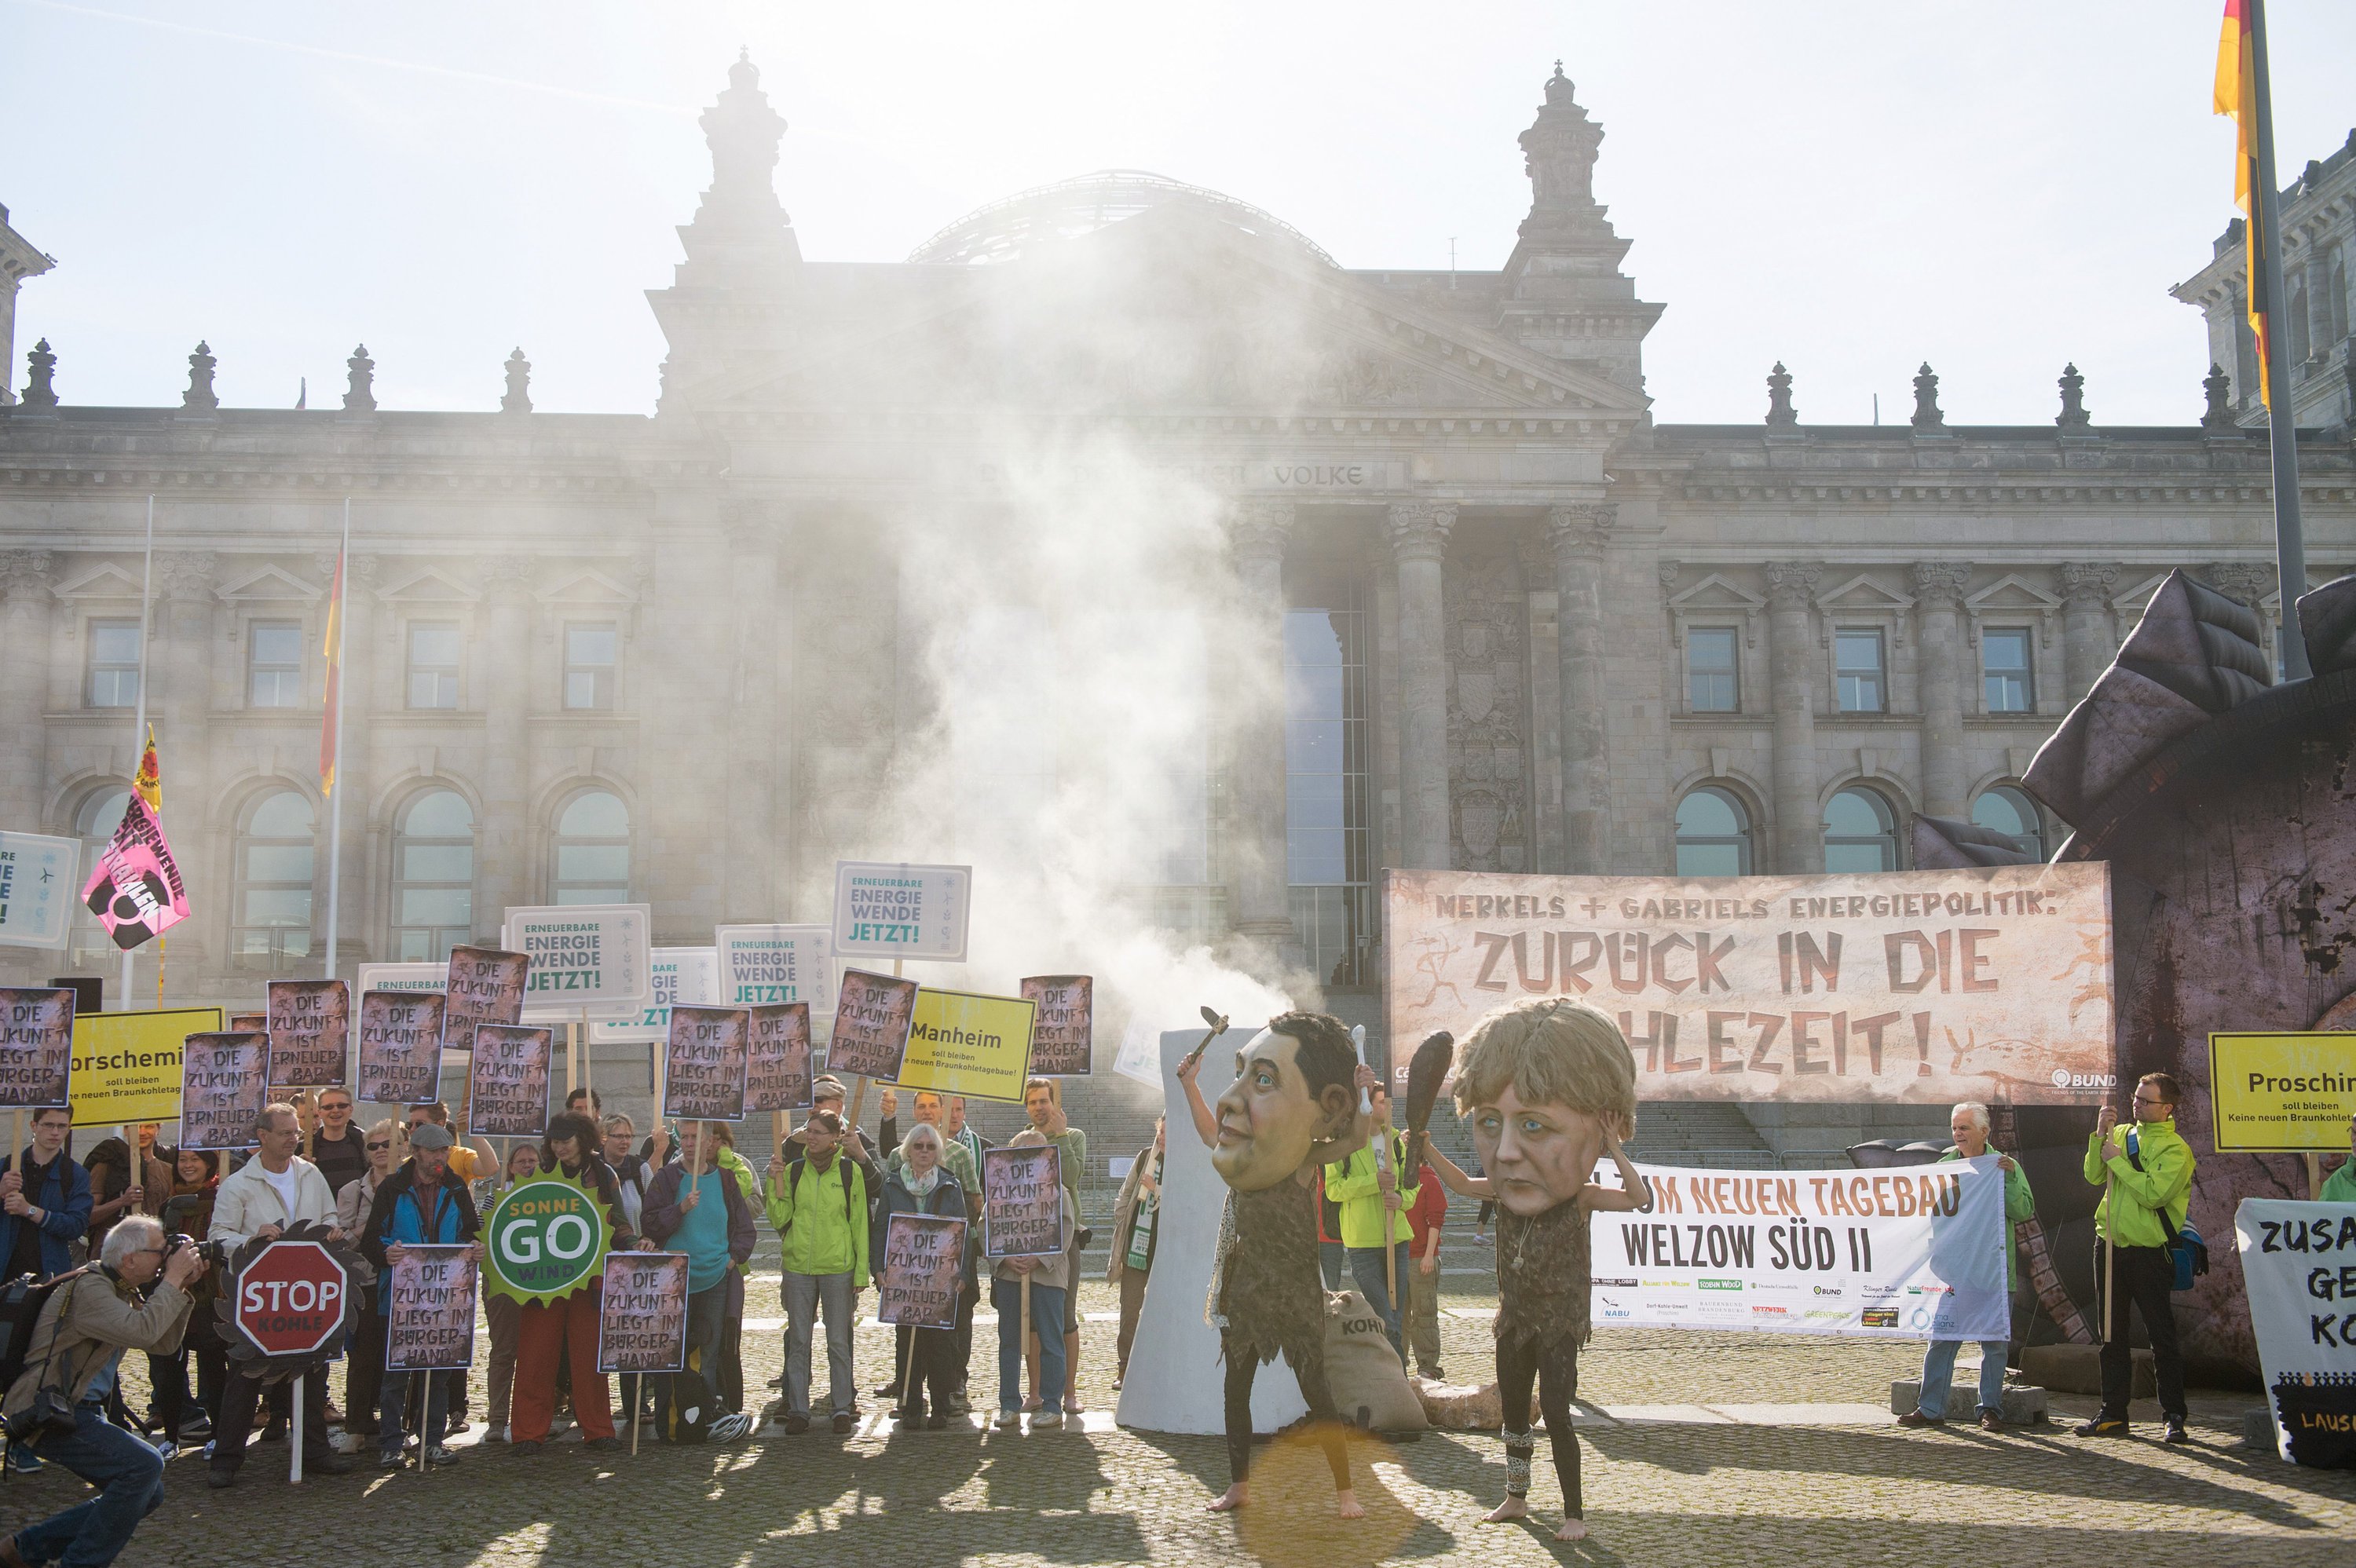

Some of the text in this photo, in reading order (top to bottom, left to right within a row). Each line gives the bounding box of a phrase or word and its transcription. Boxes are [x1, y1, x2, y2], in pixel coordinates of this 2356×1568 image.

[1274, 466, 1363, 485] VOLKE
[852, 877, 923, 888] ERNEUERBARE
[851, 889, 922, 905] ENERGIE
[1436, 894, 1565, 919] MERKELS
[1619, 897, 1768, 919] GABRIELS
[1790, 890, 2057, 919] ENERGIEPOLITIK:
[851, 905, 920, 921] WENDE
[525, 923, 600, 933] ERNEUERBARE
[848, 923, 920, 943] JETZT!
[525, 935, 600, 951] ENERGIE
[731, 941, 795, 949] ERNEUERBARE
[529, 951, 600, 968] WENDE
[732, 952, 796, 965] ENERGIE
[1473, 928, 1999, 996] ZURÜCK IN DIE
[475, 962, 501, 978] DIE
[734, 967, 796, 981] WENDE
[377, 981, 446, 990] ERNEUERBAR
[450, 979, 521, 999] ZUKUNFT
[526, 970, 601, 992] JETZT!
[734, 985, 796, 1003] JETZT!
[865, 989, 889, 1005] DIE
[1044, 990, 1067, 1004] DIE
[296, 995, 322, 1011] DIE
[471, 1000, 496, 1014] IST
[13, 1006, 42, 1022] DIE
[390, 1007, 416, 1024] DIE
[840, 1003, 906, 1028] ZUKUNFT
[1035, 1008, 1087, 1022] UKUNFT
[272, 1014, 342, 1031] ZUKUNFT
[759, 1020, 783, 1035] DIE
[0, 1028, 64, 1044] UKUNFT
[296, 1034, 320, 1047] IST
[364, 1028, 436, 1044] ZUKUNFT
[696, 1025, 722, 1040] DIE
[859, 1027, 881, 1039] IST
[910, 1022, 1002, 1049] Manheim
[1033, 1026, 1085, 1040] IEGT IN
[500, 1043, 525, 1058] DIE
[748, 1040, 805, 1055] UKUNFT
[1616, 1010, 1931, 1076] HLEZEIT!
[0, 1049, 63, 1065] EGT IN
[71, 1047, 182, 1072] orschemi
[214, 1051, 240, 1066] DIE
[272, 1050, 342, 1065] ERNEUER-
[386, 1048, 412, 1062] IST
[671, 1044, 742, 1061] ZUKUNFT
[931, 1050, 975, 1062] soll bleiben
[762, 1059, 782, 1073] IST
[850, 1054, 878, 1070] BAR
[911, 1058, 934, 1067] neuen
[936, 1060, 1017, 1077] Braunkohletagebaue!
[1037, 1058, 1074, 1071] HAND
[292, 1067, 324, 1081] BAR
[362, 1064, 432, 1080] ERNEUER-
[477, 1062, 545, 1079] ZUKUNFT
[671, 1065, 738, 1080] LIEGT IN
[106, 1076, 159, 1087] soll bleiben
[188, 1071, 263, 1087] ZUKUNFT
[747, 1074, 806, 1090] RNEUER-
[2072, 1074, 2116, 1087] BUND
[113, 1086, 181, 1097] Braunkohletag
[380, 1082, 412, 1097] BAR
[477, 1082, 541, 1098] LIEGT IN
[213, 1092, 238, 1106] IST
[759, 1092, 790, 1106] BAR
[682, 1100, 723, 1115] HAND
[488, 1117, 528, 1132] HAND
[207, 1127, 241, 1142] BAR
[1010, 1163, 1033, 1179] DIE
[990, 1182, 1055, 1201] ZUKUNFT
[1614, 1173, 1961, 1217] UM NEUEN TAGEBAU
[510, 1198, 580, 1217] SONNE
[991, 1201, 1055, 1219] LIEGT IN
[500, 1214, 591, 1264] GO
[913, 1234, 938, 1250] DIE
[2259, 1216, 2356, 1253] ZUSA
[1004, 1235, 1044, 1251] HAND
[1621, 1223, 1754, 1269] WELZOW
[1768, 1216, 1835, 1270] SÜD
[890, 1252, 956, 1269] ZUKUNFT
[422, 1264, 449, 1282] DIE
[518, 1264, 575, 1281] WIND
[632, 1272, 660, 1288] DIE
[909, 1273, 931, 1287] IST
[2307, 1266, 2356, 1302] GE
[244, 1280, 340, 1313] STOP
[395, 1287, 470, 1304] ZUKUNFT
[607, 1294, 681, 1310] ZUKUNFT
[395, 1308, 468, 1327] LIEGT IN
[903, 1305, 933, 1320] BAR
[258, 1315, 323, 1332] KOHLE
[607, 1315, 678, 1331] LIEGT IN
[406, 1347, 452, 1365] HAND
[618, 1352, 662, 1369] HAND
